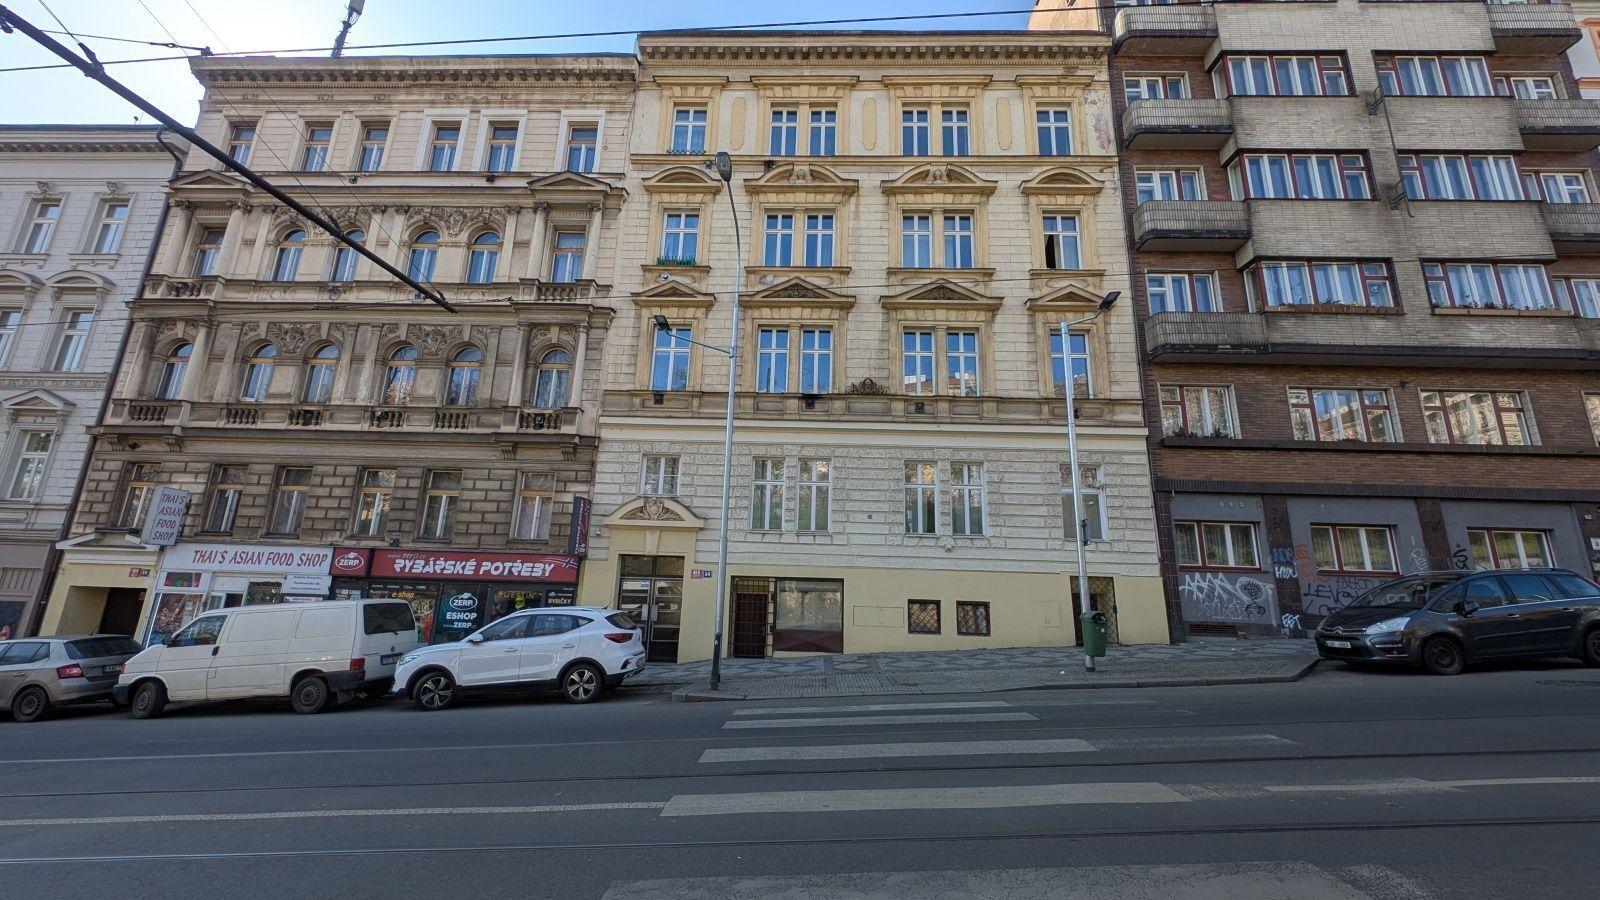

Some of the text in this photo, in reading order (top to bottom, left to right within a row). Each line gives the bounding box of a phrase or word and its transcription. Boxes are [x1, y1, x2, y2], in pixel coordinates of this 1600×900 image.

[161, 494, 186, 504] THAI'S
[159, 506, 183, 516] ASIAN
[156, 518, 176, 529] FOOD
[153, 530, 174, 541] SHOP
[192, 550, 328, 568] THAI'S ASIAN FOOD SHOP
[339, 558, 360, 567] ZERP
[393, 557, 555, 577] RYBÁŘSKÉ POTŘEBY
[453, 598, 474, 607] ZERP
[446, 611, 477, 621] ESHOP
